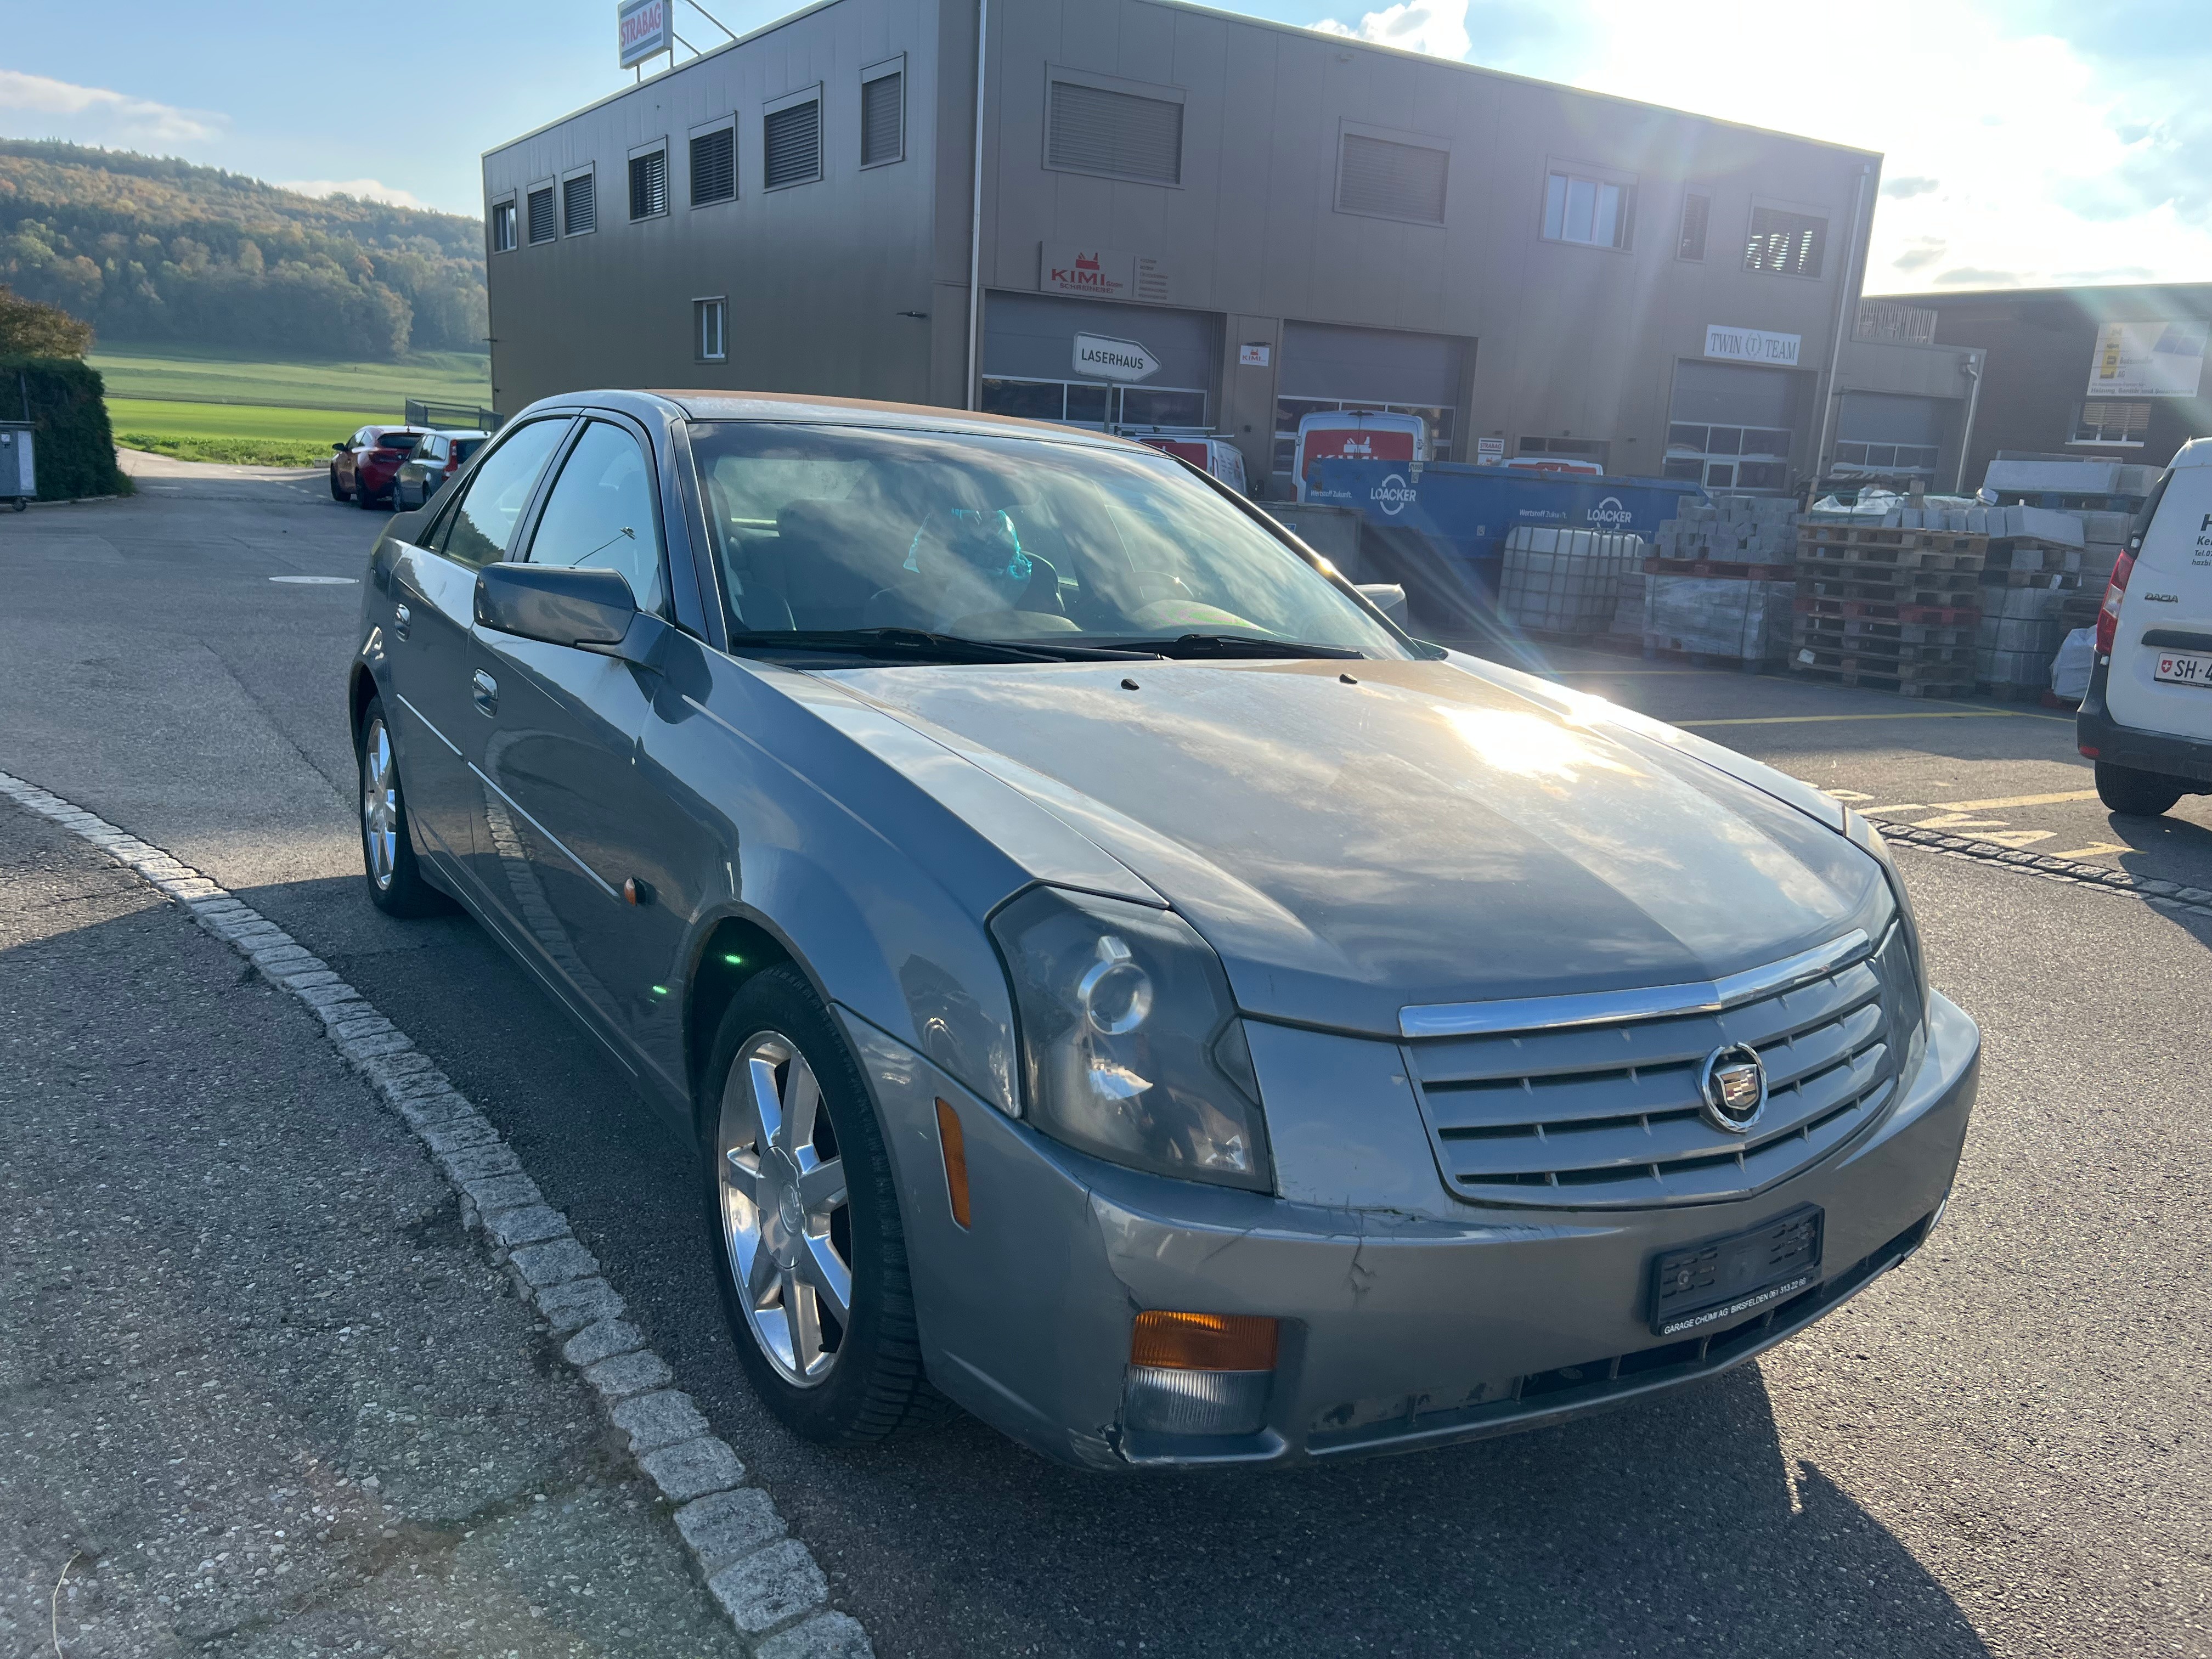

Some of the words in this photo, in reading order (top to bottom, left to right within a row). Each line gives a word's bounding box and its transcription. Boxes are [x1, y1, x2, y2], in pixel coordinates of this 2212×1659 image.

[620, 3, 662, 47] STRABAG
[1051, 268, 1105, 286] KIMI
[1059, 283, 1115, 294] SCHREINEREI
[1711, 333, 1742, 354] TWIN
[1765, 339, 1797, 360] TEAM
[1081, 348, 1144, 370] LASERHAUS
[1370, 487, 1417, 501] LOACKER
[1587, 509, 1632, 523] LOACKER
[2145, 592, 2179, 603] DACIA
[1664, 1319, 1694, 1334] GARAGE
[1718, 1308, 1729, 1318] AG
[1730, 1293, 1769, 1313] BIRSFELDEN
[1769, 1288, 1779, 1299] 061
[1780, 1283, 1790, 1294] 313
[1791, 1280, 1798, 1290] 22
